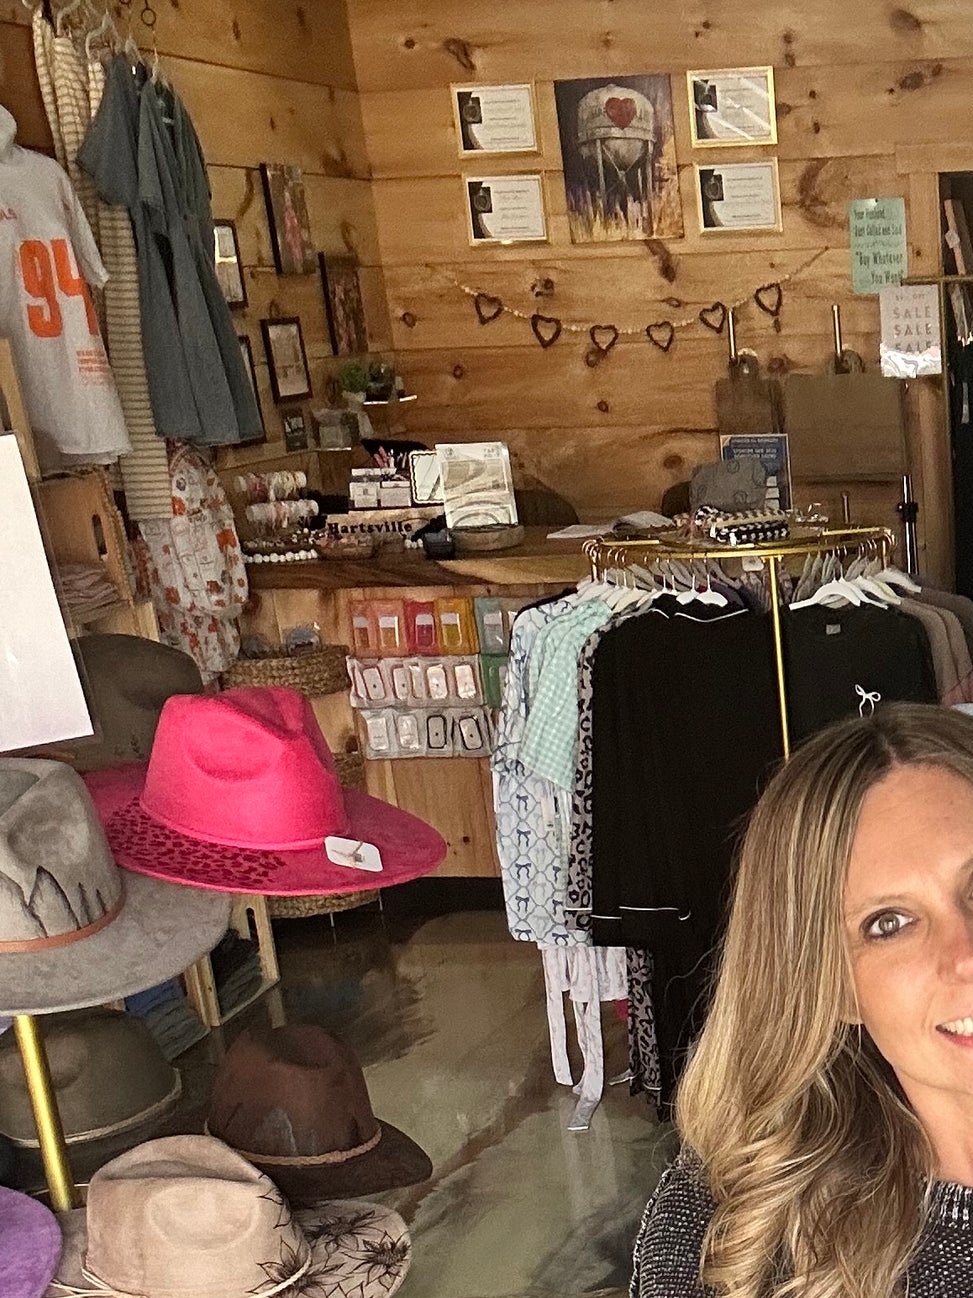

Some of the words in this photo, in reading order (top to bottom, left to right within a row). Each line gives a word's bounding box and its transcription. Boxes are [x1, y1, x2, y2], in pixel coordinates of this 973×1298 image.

[19, 239, 99, 338] 94
[893, 306, 931, 319] SALE
[894, 323, 931, 337] SALE
[327, 522, 413, 536] Hartsville
